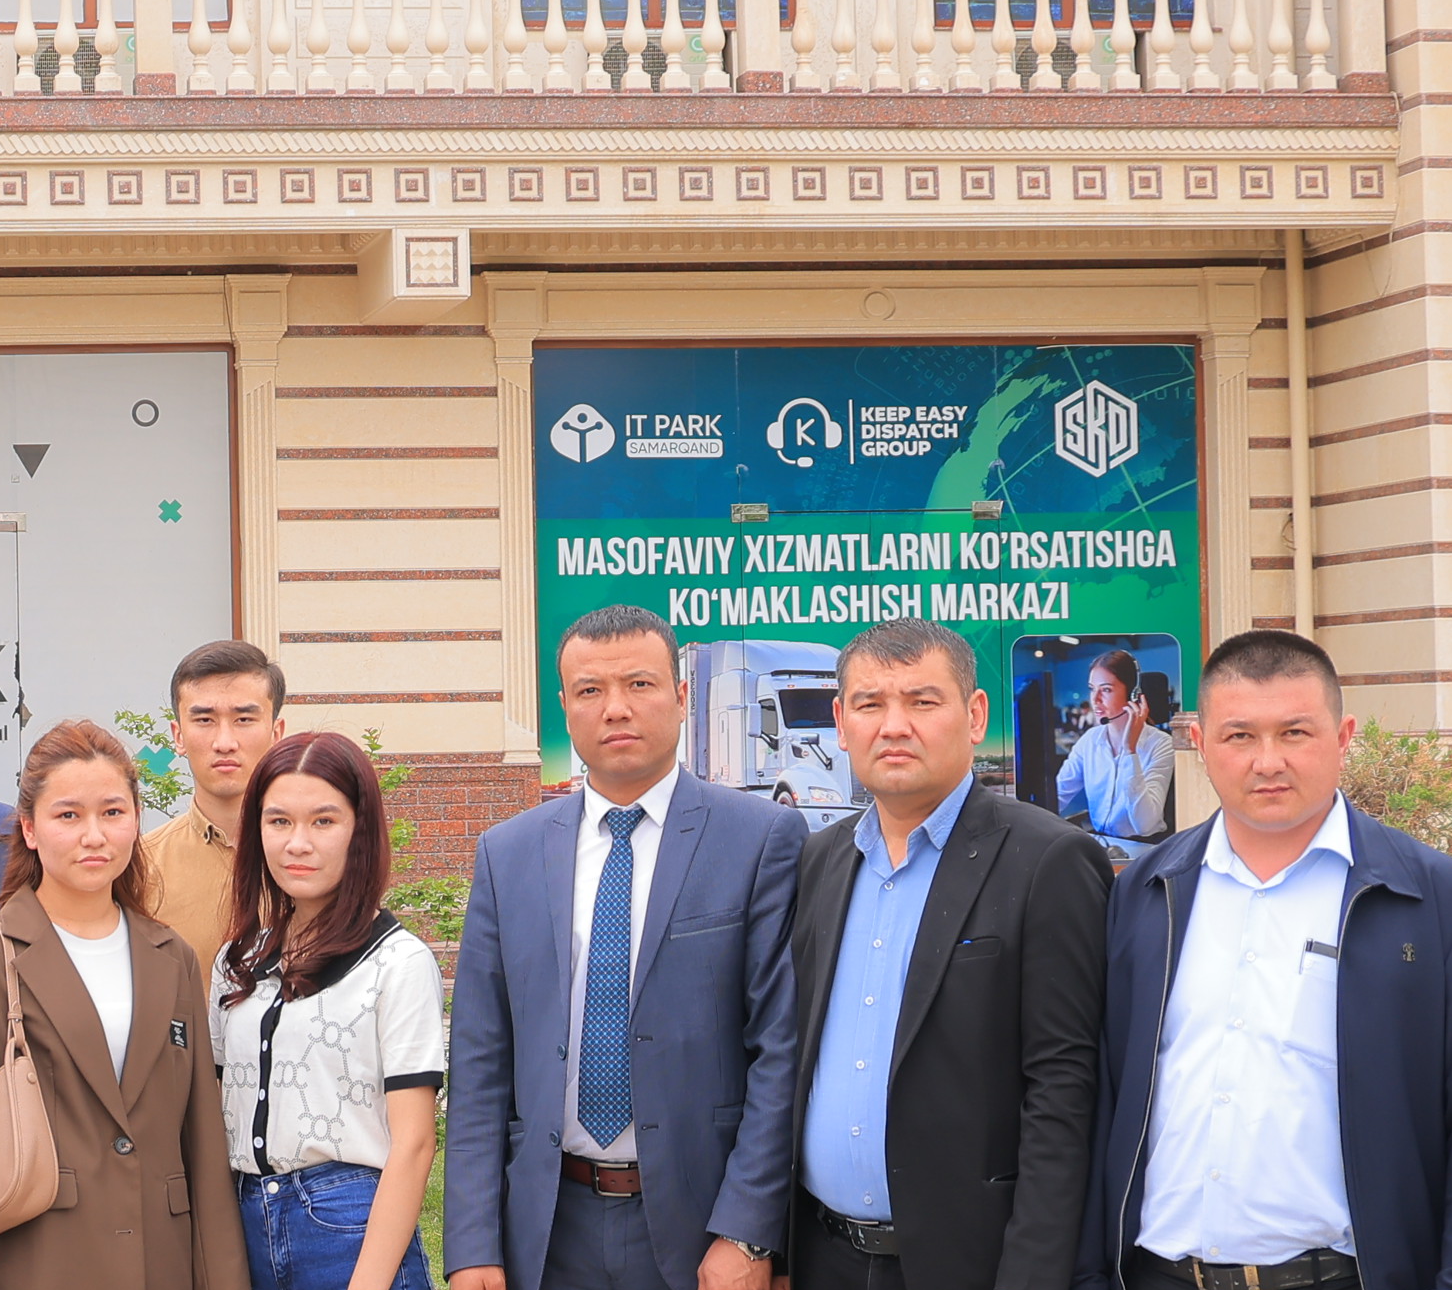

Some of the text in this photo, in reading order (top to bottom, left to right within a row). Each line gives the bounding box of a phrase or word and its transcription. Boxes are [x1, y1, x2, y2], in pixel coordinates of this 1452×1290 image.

[860, 405, 968, 422] KEEP EASY
[625, 414, 722, 437] IT PARK
[797, 418, 816, 446] K
[861, 423, 959, 439] DISPATCH
[629, 442, 720, 455] SAMARQAND
[861, 440, 932, 457] GROUP
[557, 536, 735, 576] MASOFAVIY
[744, 532, 951, 573] XIZMATLARNI
[930, 582, 1070, 621] MARKAZI
